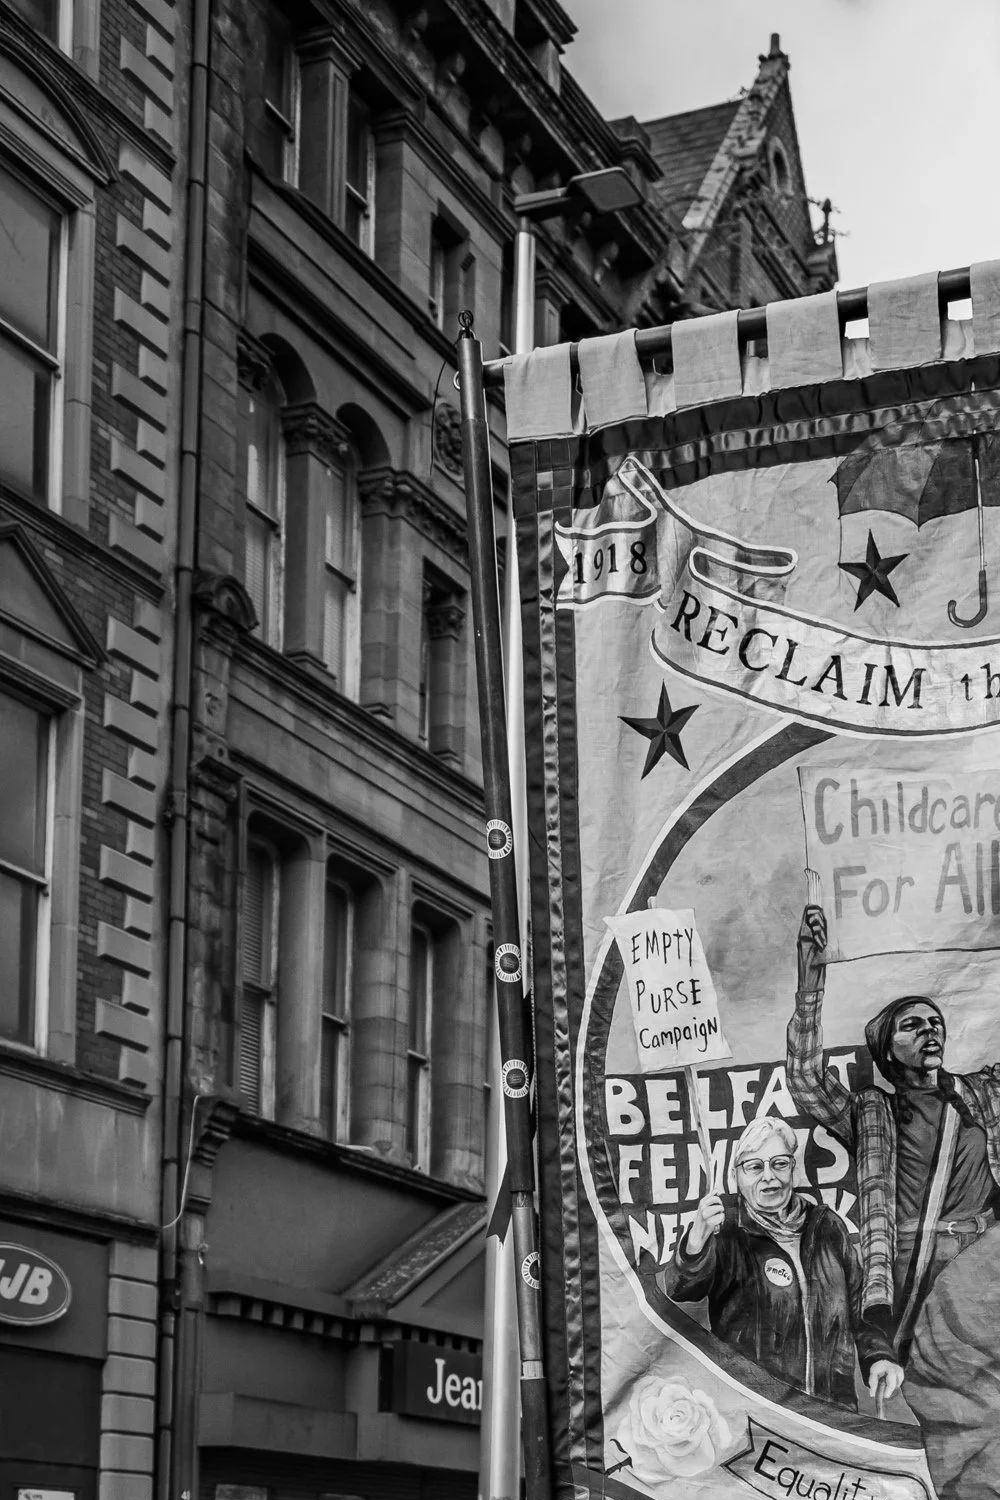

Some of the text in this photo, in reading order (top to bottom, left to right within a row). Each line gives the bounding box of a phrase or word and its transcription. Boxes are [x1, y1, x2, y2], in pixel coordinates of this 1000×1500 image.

[573, 540, 648, 585] 1918
[670, 590, 926, 710] RECLAIM
[832, 840, 1000, 920] For All
[635, 978, 702, 1014] PURSE
[605, 1051, 857, 1136] BELFAT
